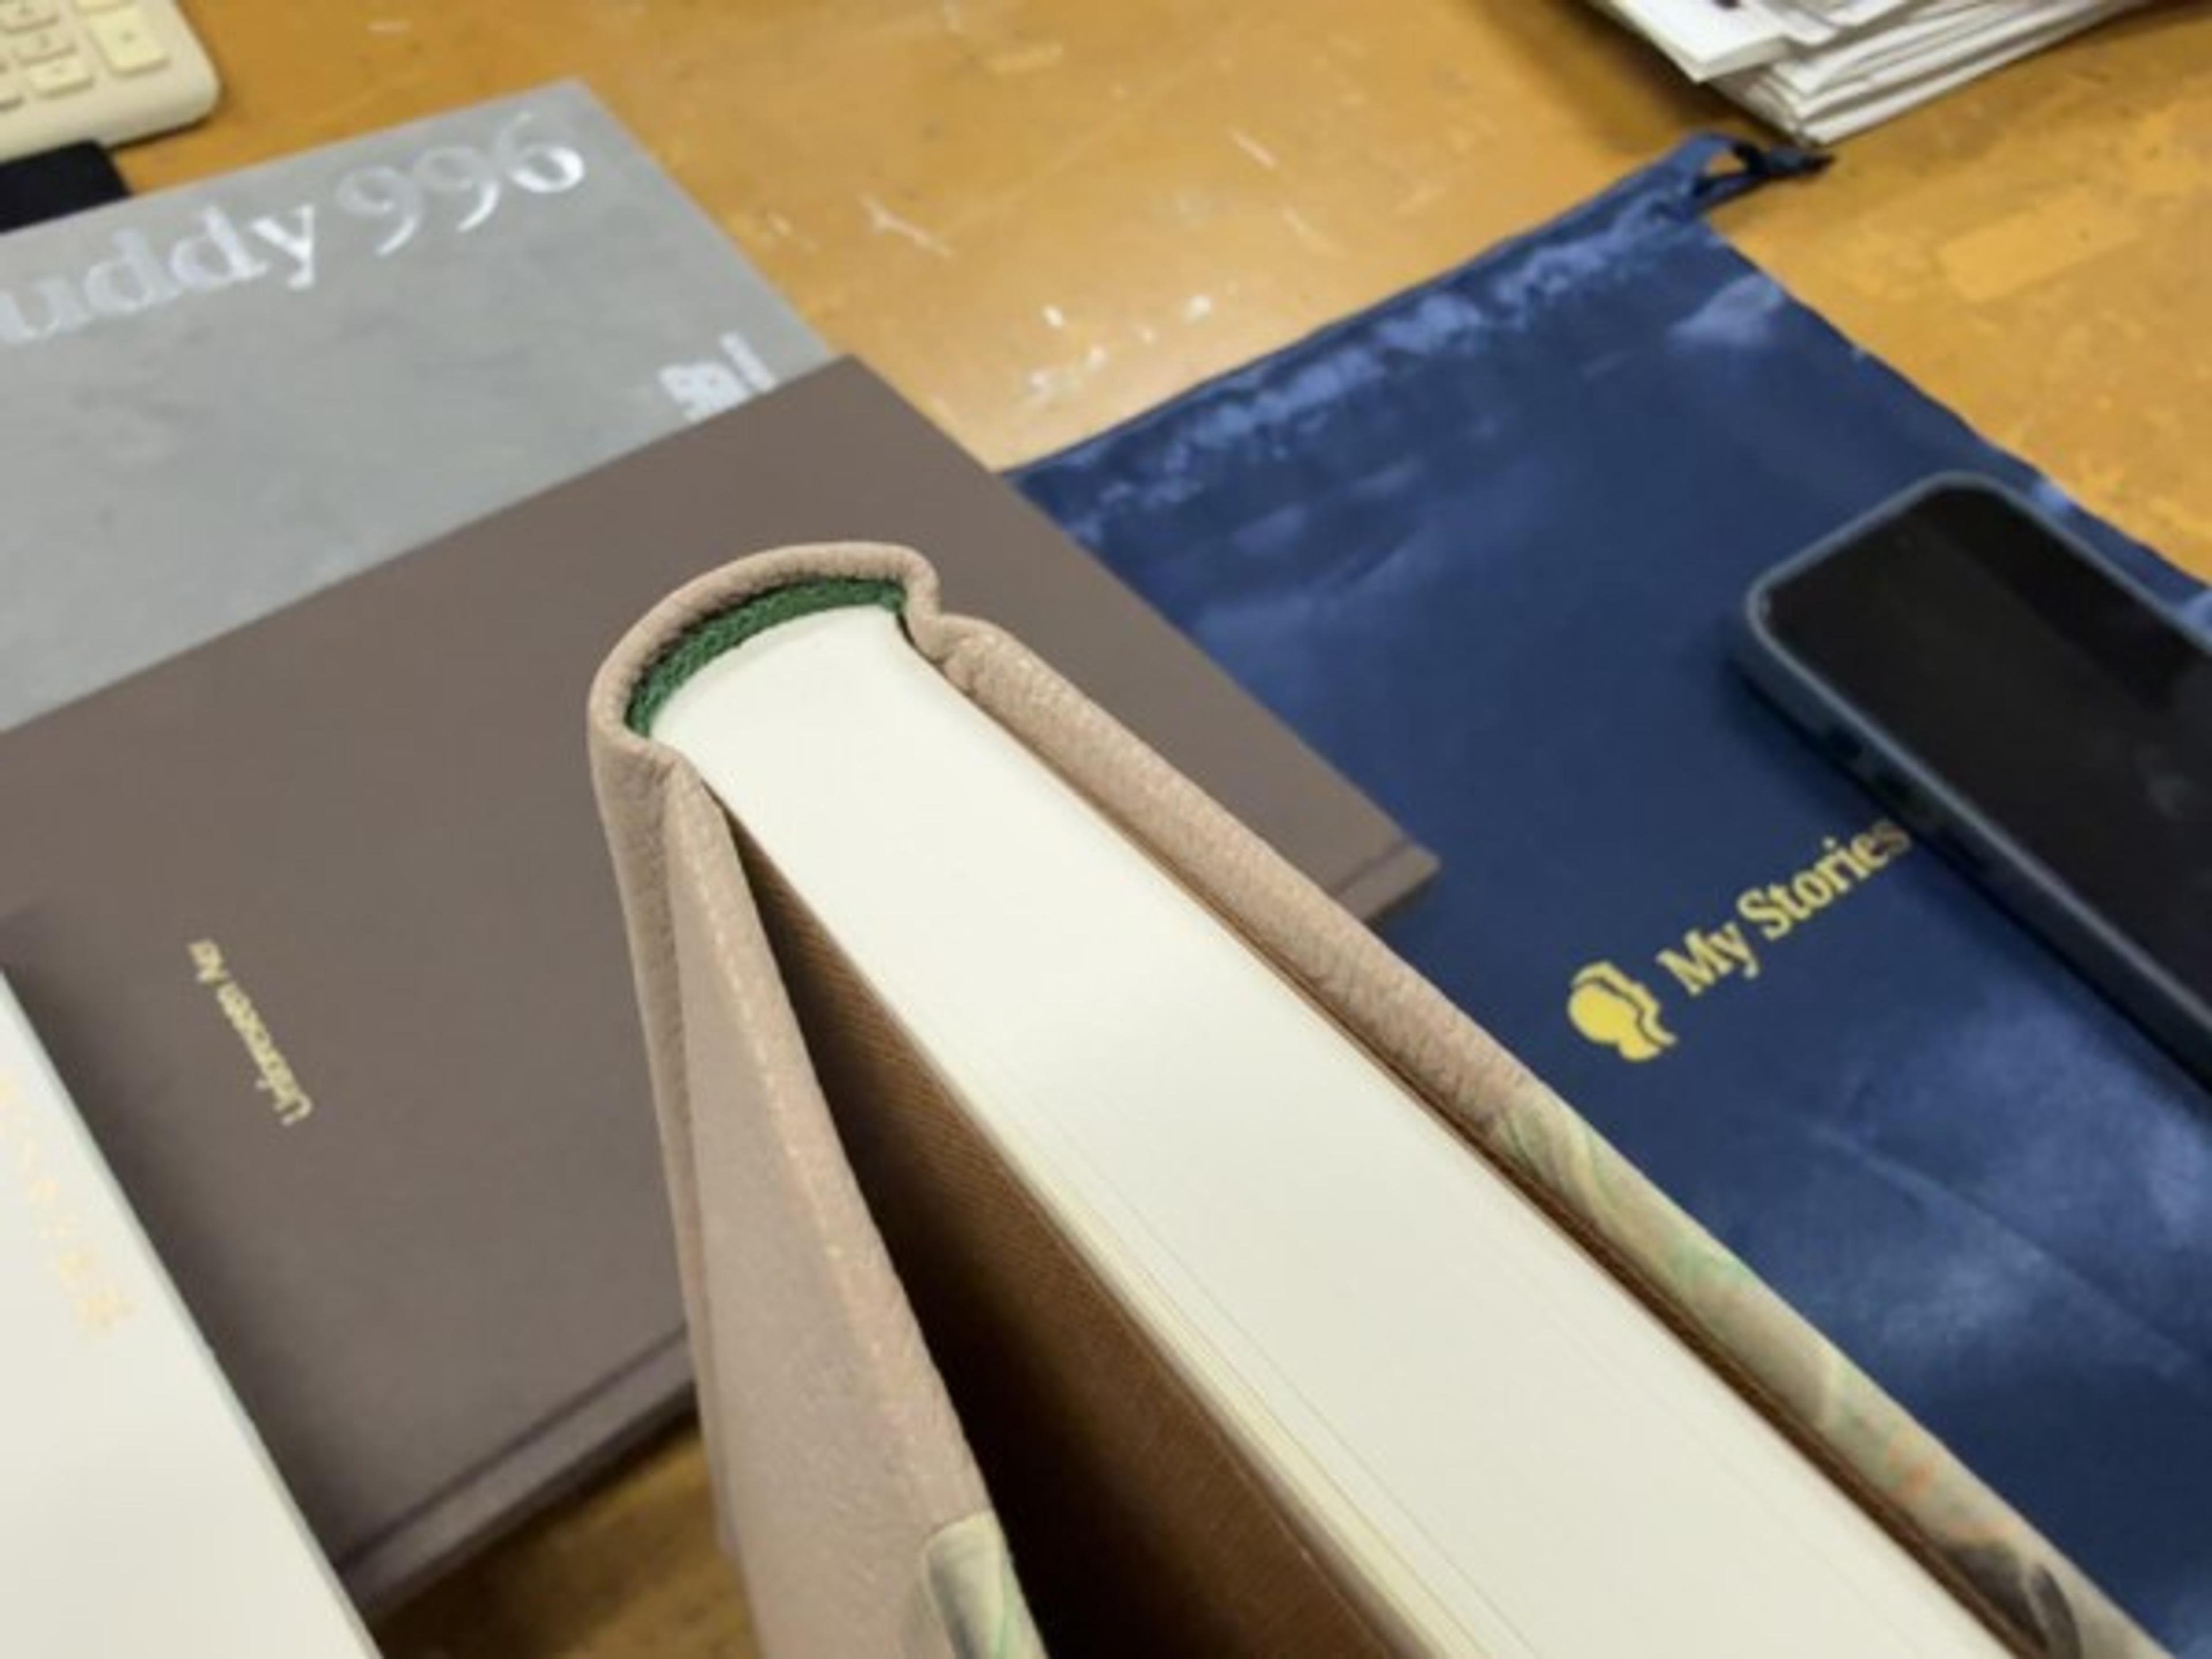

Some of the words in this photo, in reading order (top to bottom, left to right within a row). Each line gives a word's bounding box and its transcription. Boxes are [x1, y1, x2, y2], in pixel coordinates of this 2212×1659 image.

[337, 113, 585, 256] 996
[1657, 923, 1758, 995] My
[1738, 821, 1910, 939] Stories
